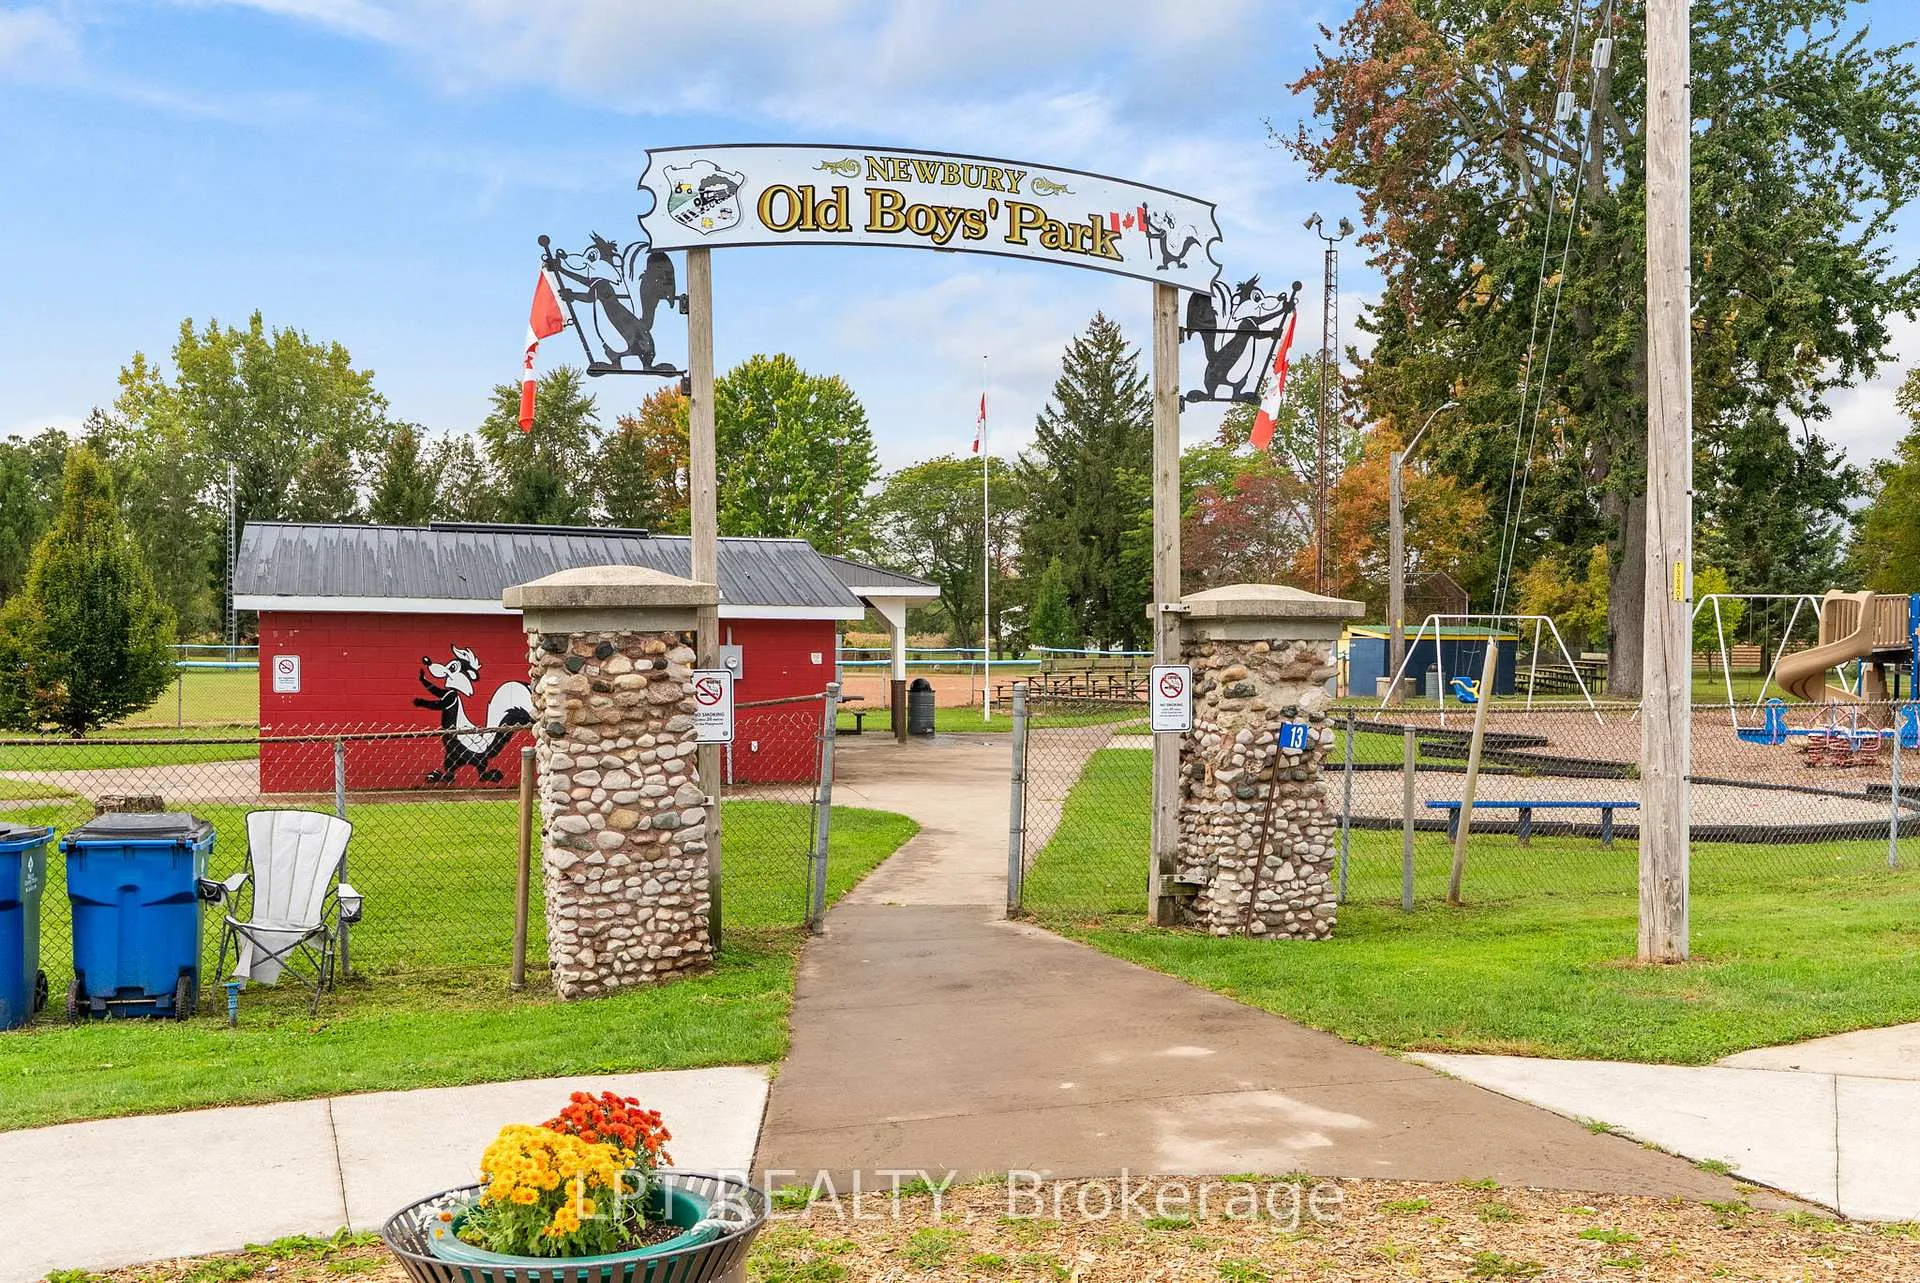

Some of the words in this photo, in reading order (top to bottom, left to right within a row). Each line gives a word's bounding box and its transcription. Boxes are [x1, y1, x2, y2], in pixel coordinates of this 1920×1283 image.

[864, 155, 1027, 194] NEWBURY
[757, 184, 853, 233] Old
[865, 187, 999, 246] Boys'
[1004, 200, 1124, 262] Park
[1290, 726, 1304, 748] 13
